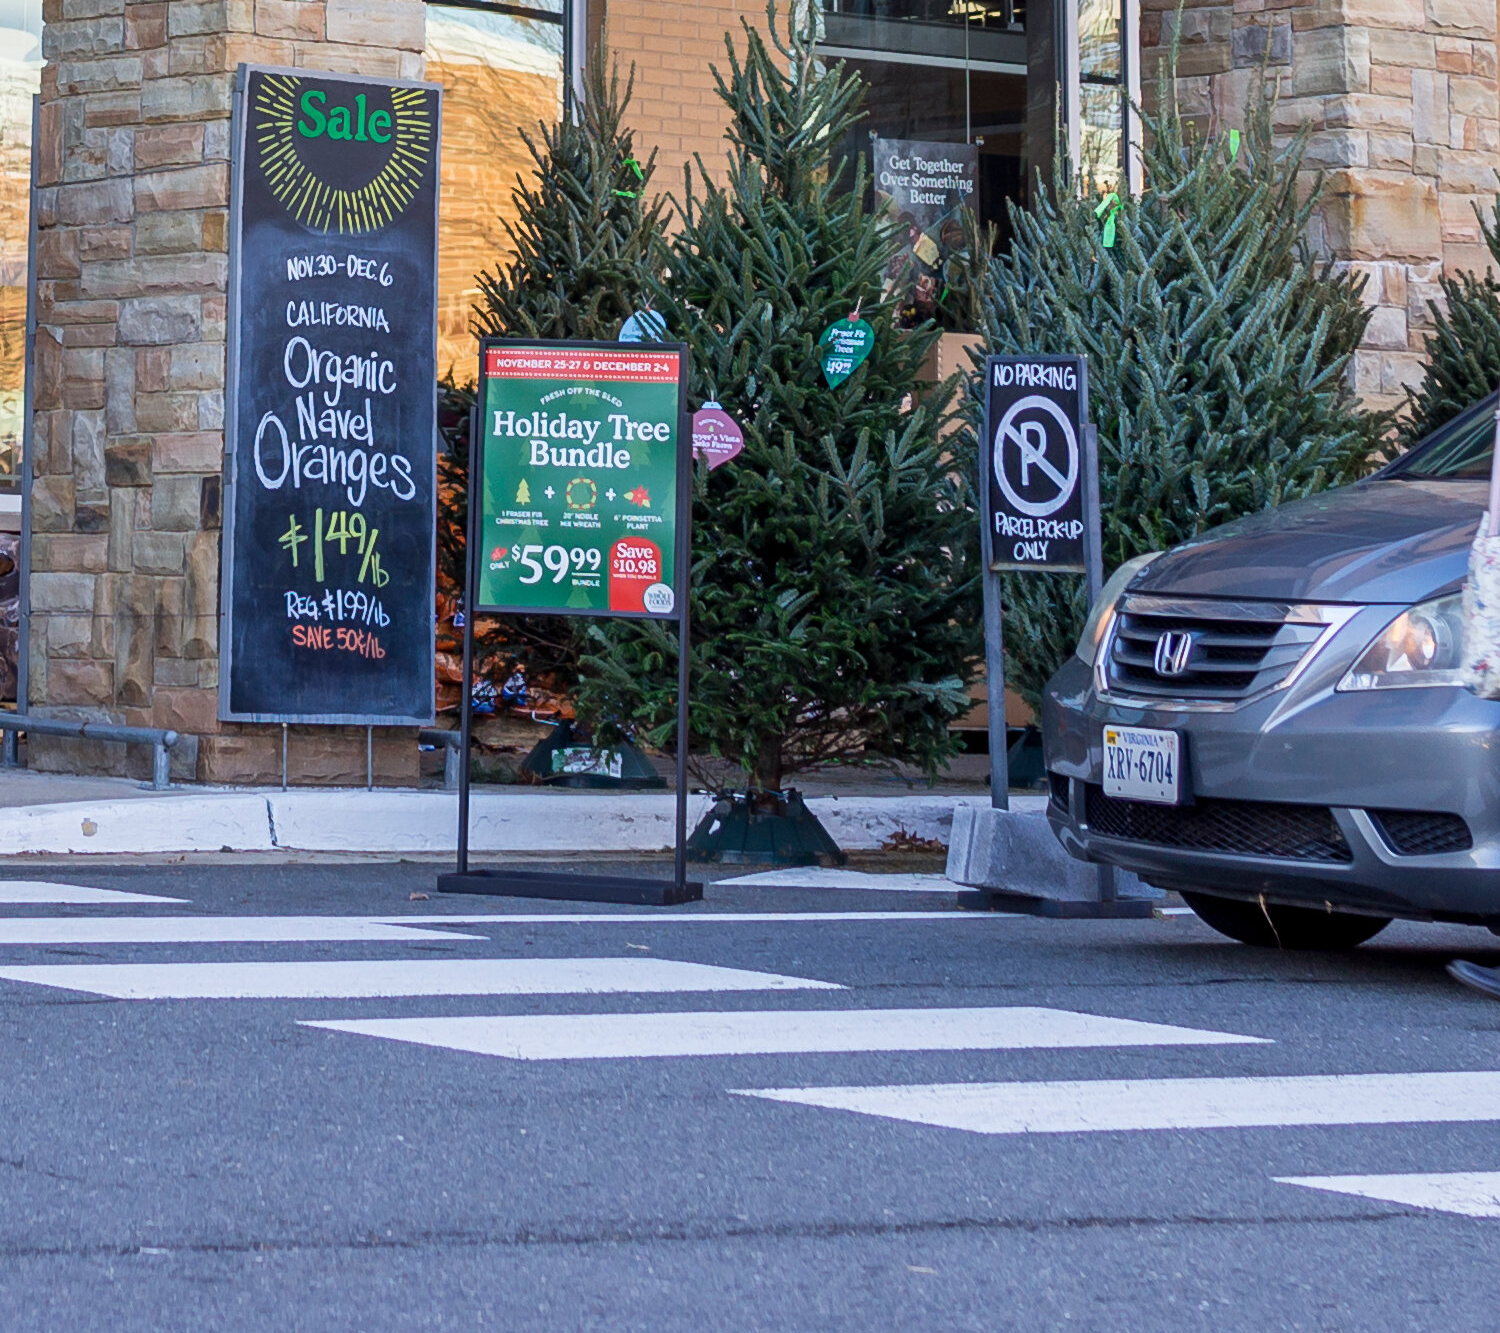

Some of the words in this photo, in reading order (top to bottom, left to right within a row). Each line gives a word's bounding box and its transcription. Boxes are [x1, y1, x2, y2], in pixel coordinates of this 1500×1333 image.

[298, 90, 392, 143] Sale
[889, 155, 912, 171] Get
[913, 156, 964, 175] Together
[879, 171, 909, 187] Over
[911, 173, 973, 194] Something
[910, 188, 947, 206] Better
[286, 300, 390, 334] CALIFORNIA
[283, 336, 397, 407] Organic
[497, 358, 551, 369] NOVEMBER
[553, 359, 581, 370] 25-27
[583, 360, 590, 370] &
[593, 361, 652, 372] DECEMBER
[653, 362, 670, 373] 2-4
[993, 364, 1014, 387] NO
[1015, 363, 1077, 391] PARKING
[539, 388, 566, 406] FRESH
[567, 387, 583, 395] OFF
[584, 387, 600, 397] THE
[601, 391, 623, 408] SLED
[296, 391, 373, 447] Navel
[493, 411, 600, 445] Holiday
[607, 414, 670, 441] Tree
[254, 410, 416, 507] Oranges
[529, 440, 630, 469] Bundle
[495, 518, 531, 526] CHRISTMAS
[622, 515, 663, 523] POINSETTIA
[627, 522, 649, 530] PLANT
[995, 512, 1037, 537] PARCEL
[1038, 520, 1084, 540] PICK-UP
[617, 542, 653, 559] Save
[1013, 540, 1049, 561] ONLY
[489, 561, 510, 570] ONLY
[613, 559, 657, 574] $10.98
[571, 579, 600, 587] BUNDLE
[647, 590, 671, 599] WHOLE
[648, 598, 671, 606] FOODS
[292, 624, 335, 651] SAVE
[1122, 732, 1160, 748] VIRGINIA
